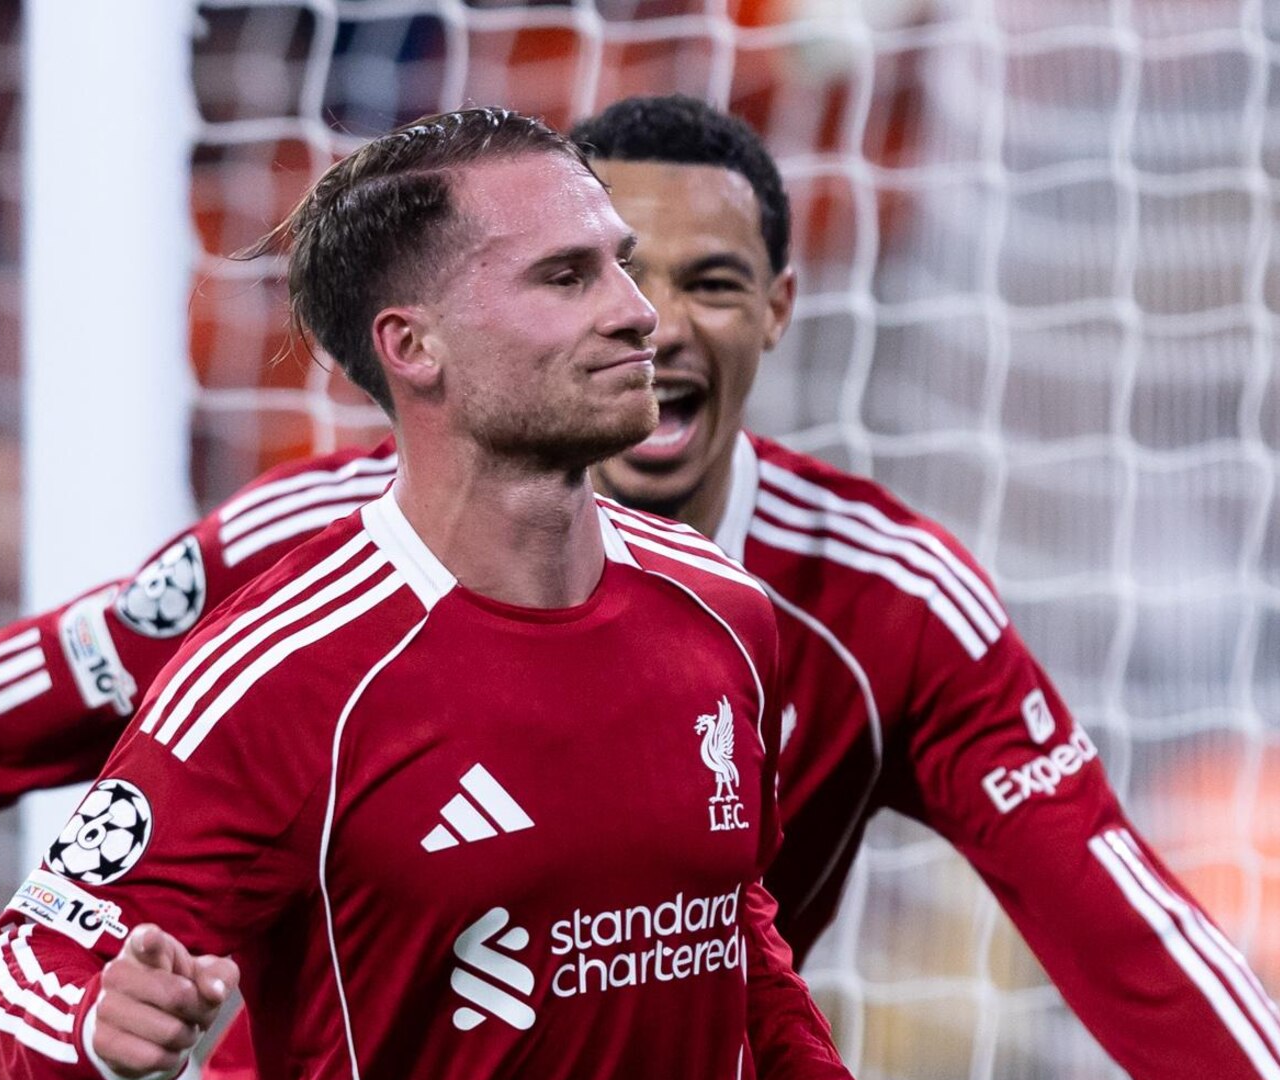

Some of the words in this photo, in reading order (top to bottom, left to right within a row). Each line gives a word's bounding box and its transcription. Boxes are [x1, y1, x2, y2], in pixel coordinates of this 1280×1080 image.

[66, 899, 103, 931] 10
[550, 882, 741, 955] standard
[551, 926, 740, 998] chartered
